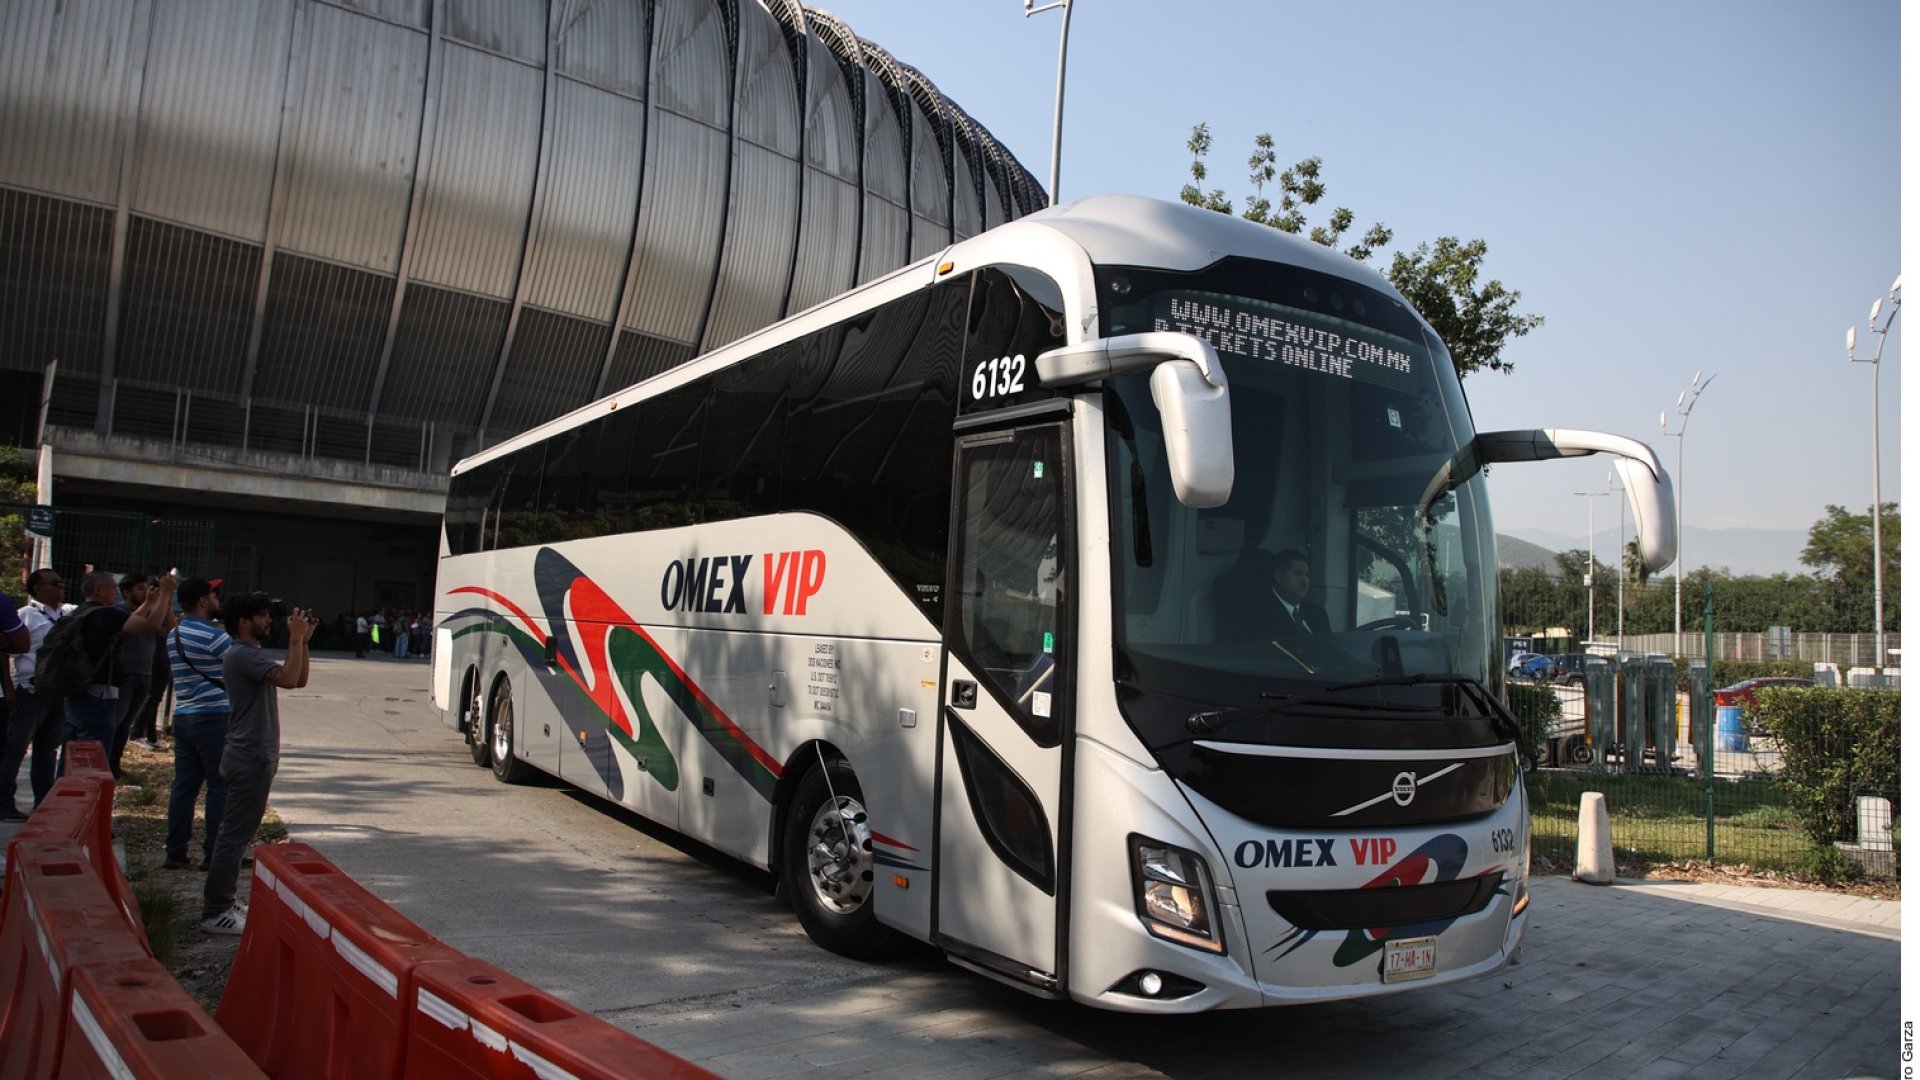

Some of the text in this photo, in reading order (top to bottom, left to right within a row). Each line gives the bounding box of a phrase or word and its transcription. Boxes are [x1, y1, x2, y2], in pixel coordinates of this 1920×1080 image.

[1171, 298, 1411, 373] WWW.OMEXVIP.COM.MX
[972, 353, 1026, 400] 6132
[1282, 344, 1353, 378] ONLINE
[661, 549, 826, 616] OMEX VIP
[1234, 837, 1397, 868] OMEX VIP
[1492, 828, 1515, 852] 6132
